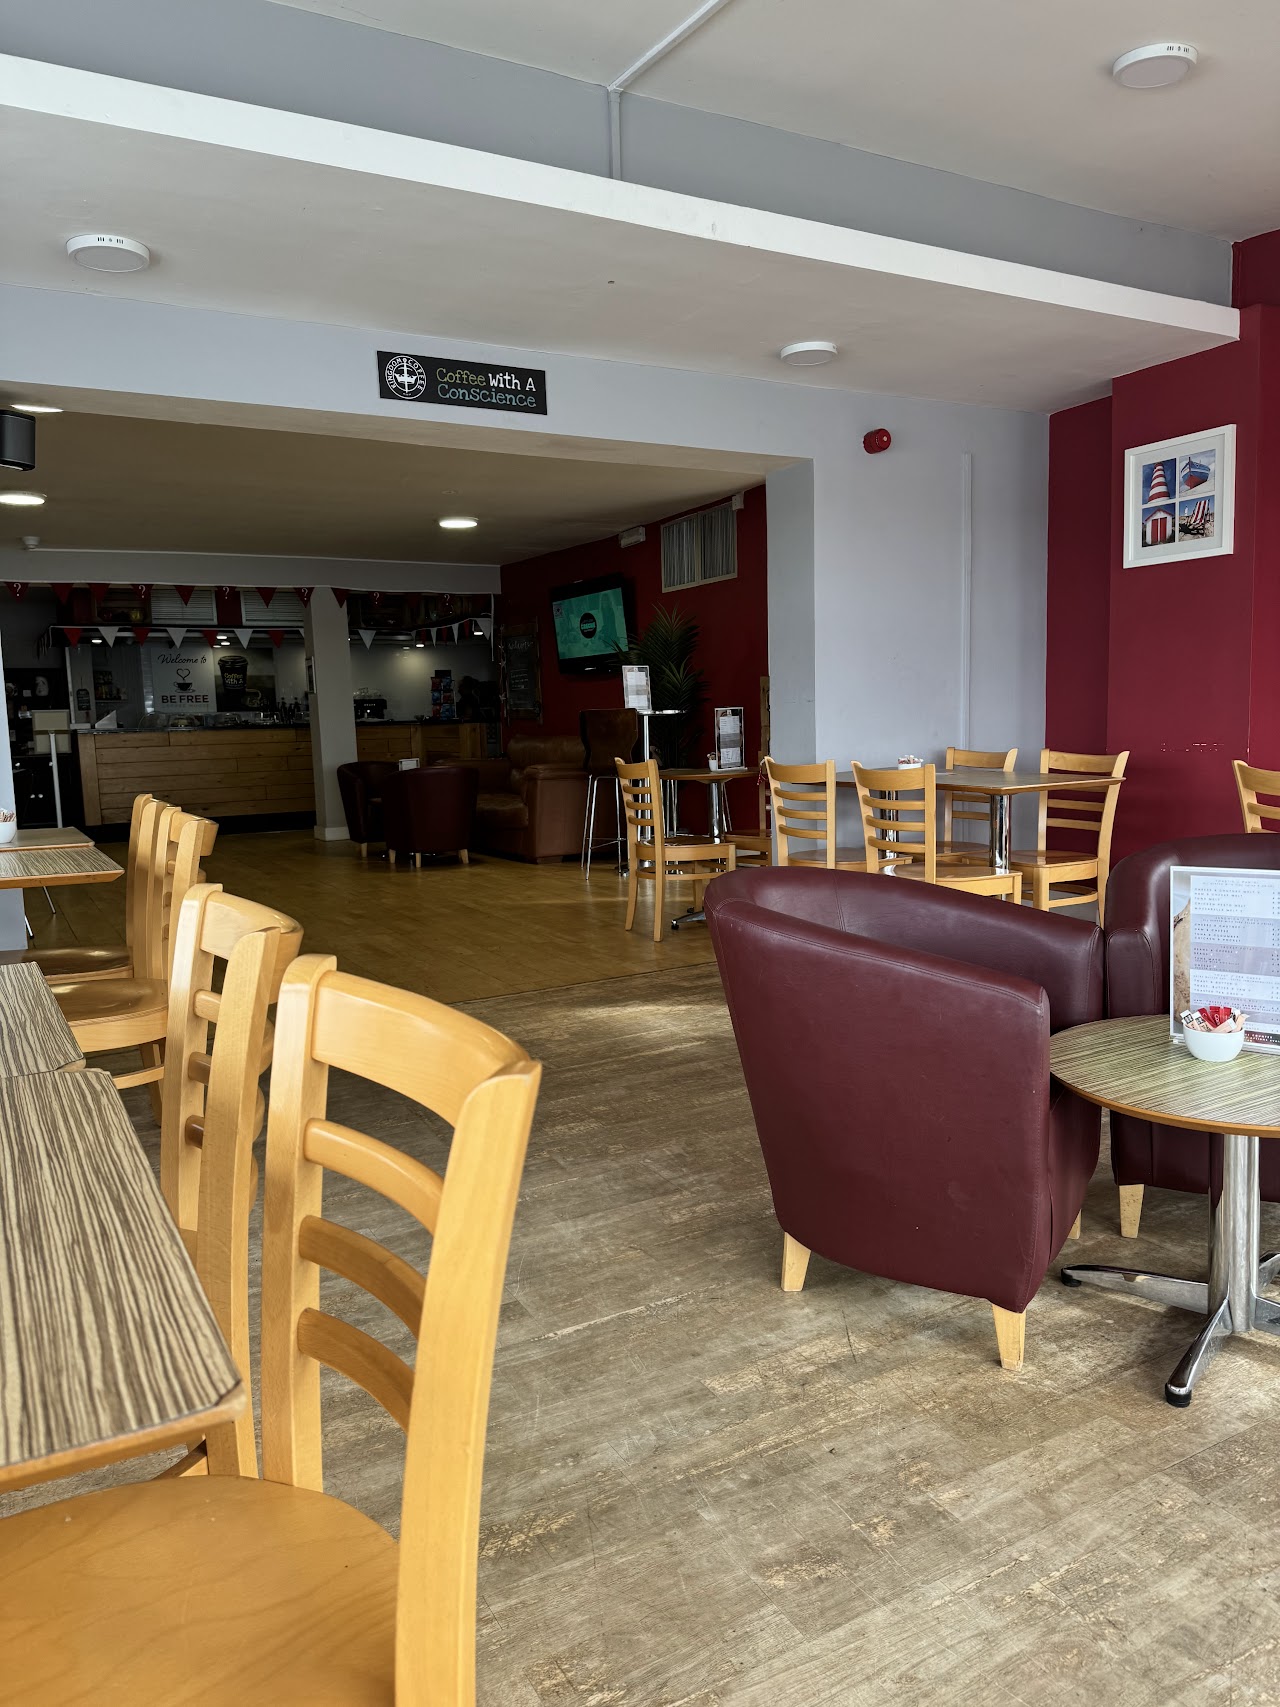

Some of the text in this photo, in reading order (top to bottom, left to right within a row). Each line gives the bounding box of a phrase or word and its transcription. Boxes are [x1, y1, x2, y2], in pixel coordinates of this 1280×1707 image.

[387, 358, 425, 391] KINGDOM COFFEE
[436, 367, 486, 386] Coffee
[525, 377, 536, 392] A
[157, 653, 207, 664] Welcome to
[161, 694, 209, 704] BE FREE
